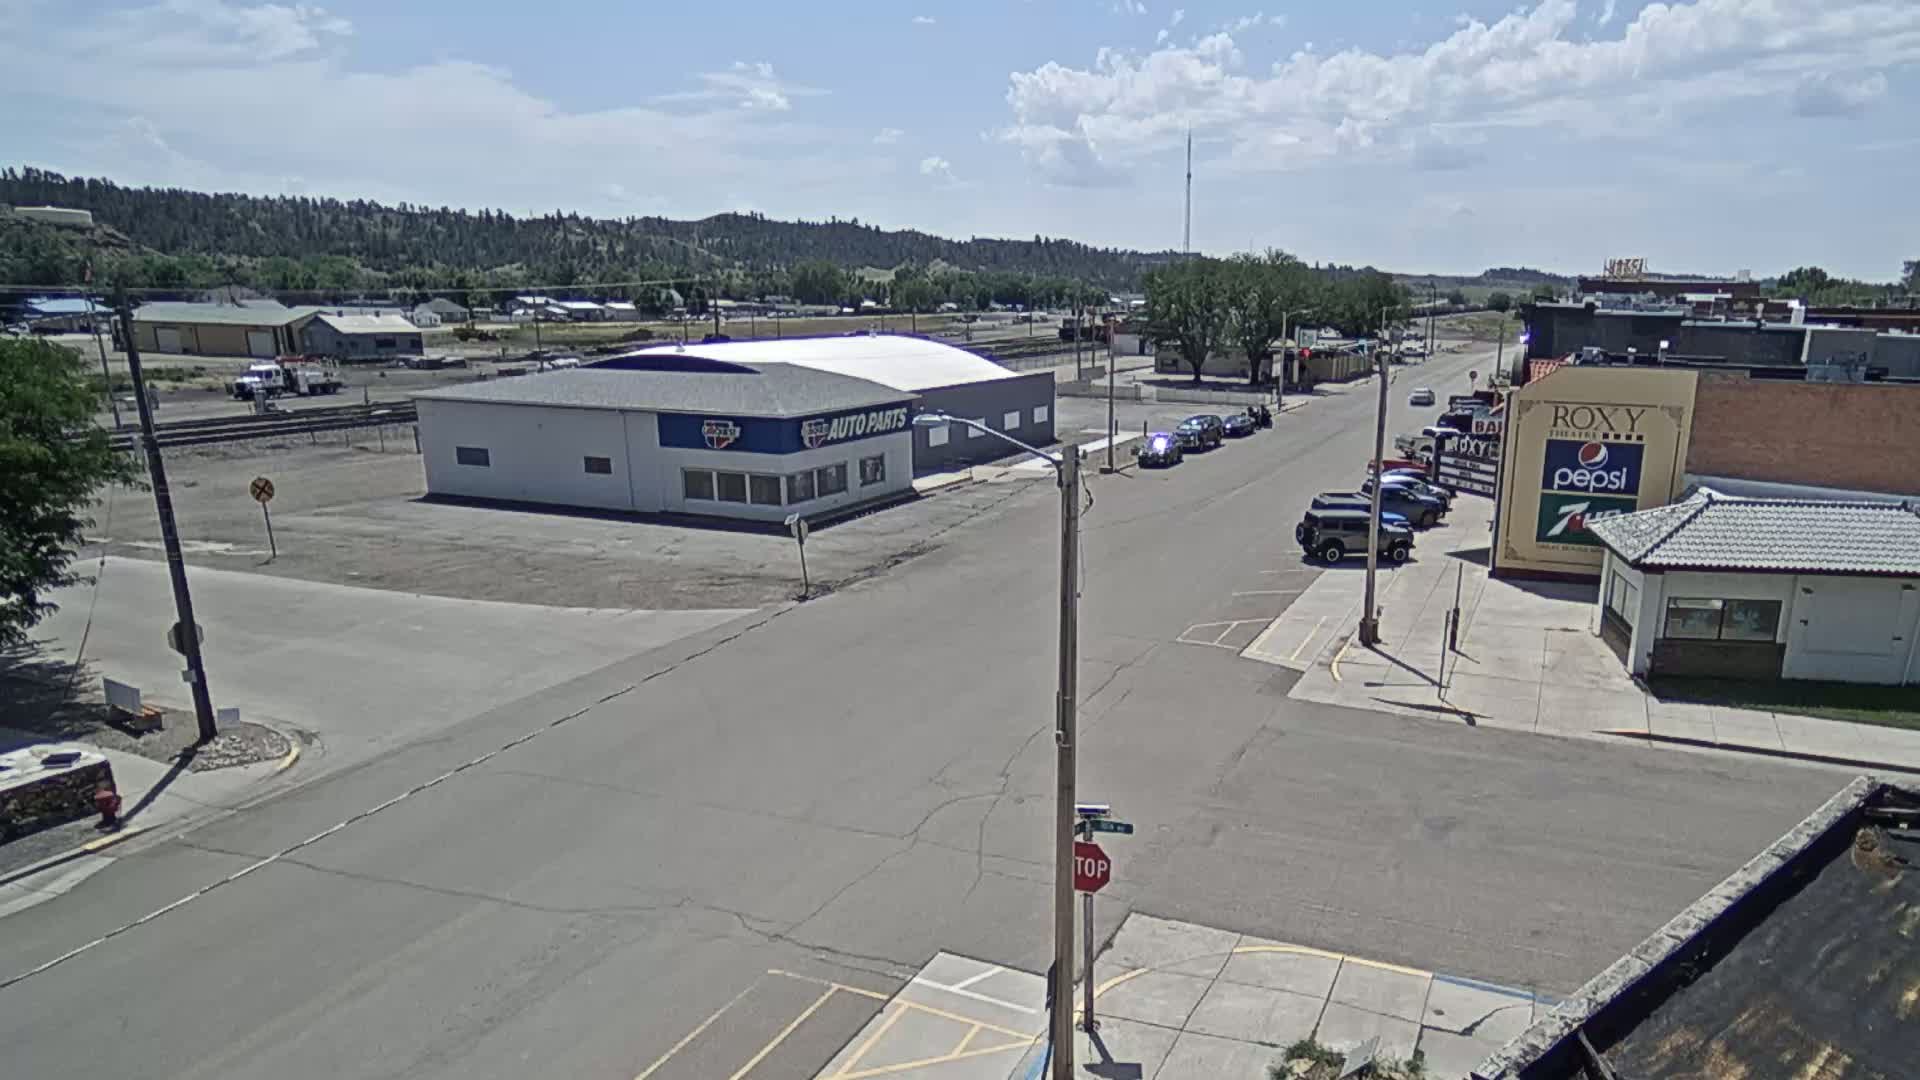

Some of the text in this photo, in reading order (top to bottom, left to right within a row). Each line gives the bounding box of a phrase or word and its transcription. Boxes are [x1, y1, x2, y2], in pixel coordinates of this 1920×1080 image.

[827, 415, 865, 441] AUTO
[867, 407, 908, 435] PARTS
[1552, 404, 1646, 433] ROXY
[1553, 466, 1628, 493] pepsi
[1074, 856, 1108, 880] TOP
